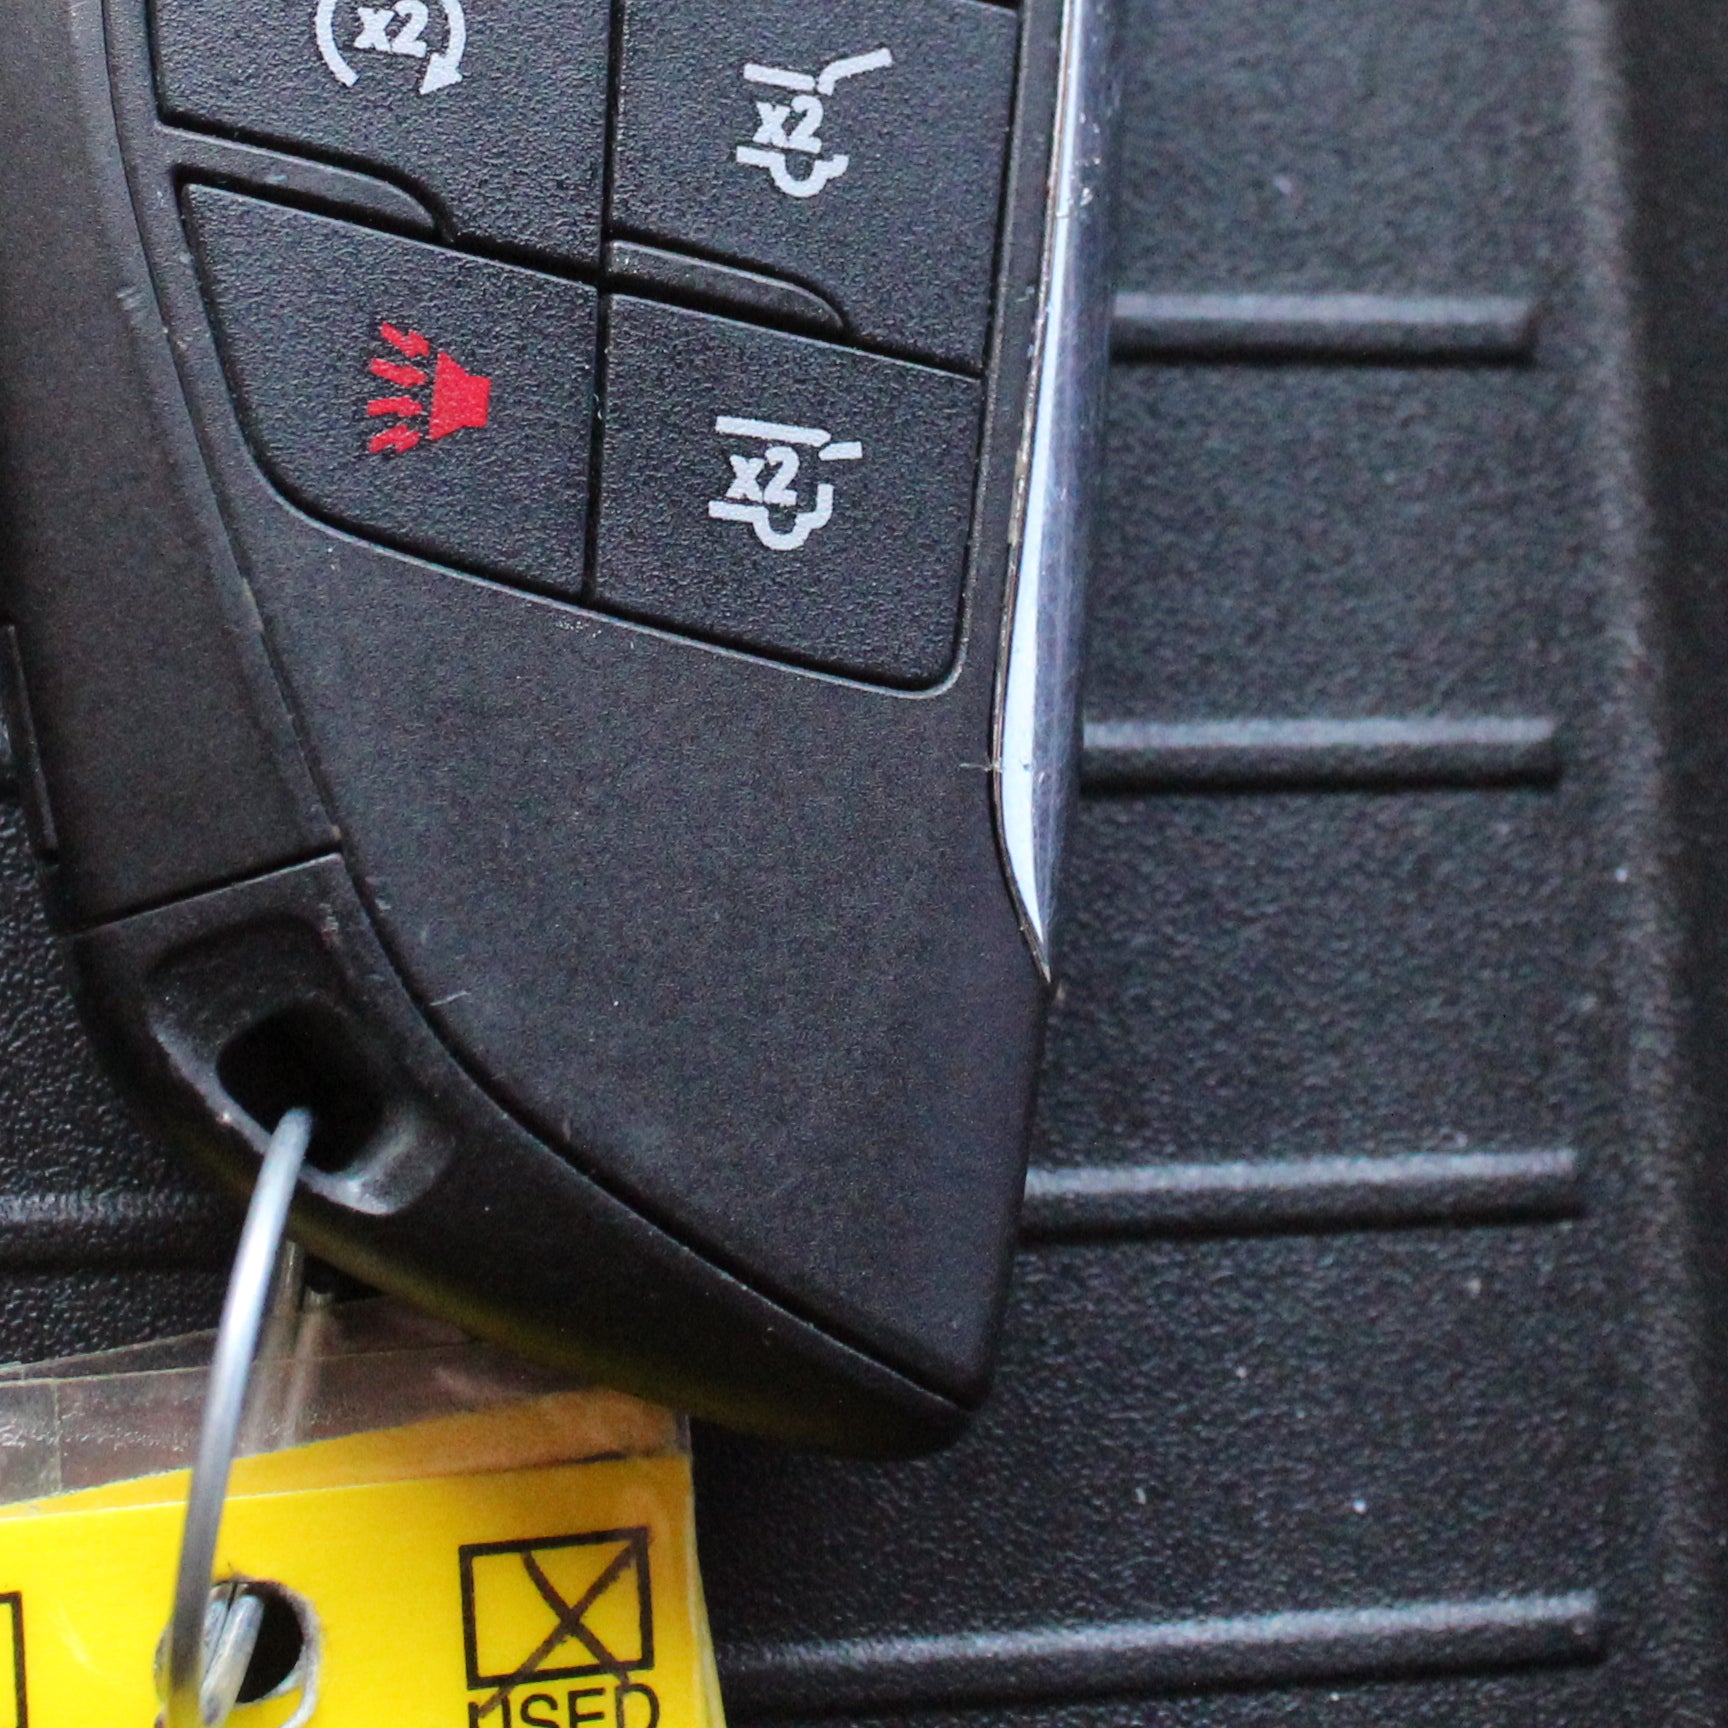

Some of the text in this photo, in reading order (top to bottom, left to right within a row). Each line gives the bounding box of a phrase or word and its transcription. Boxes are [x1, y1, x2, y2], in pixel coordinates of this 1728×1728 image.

[353, 0, 429, 60] x2
[753, 94, 825, 155] x2
[726, 445, 799, 508] x2
